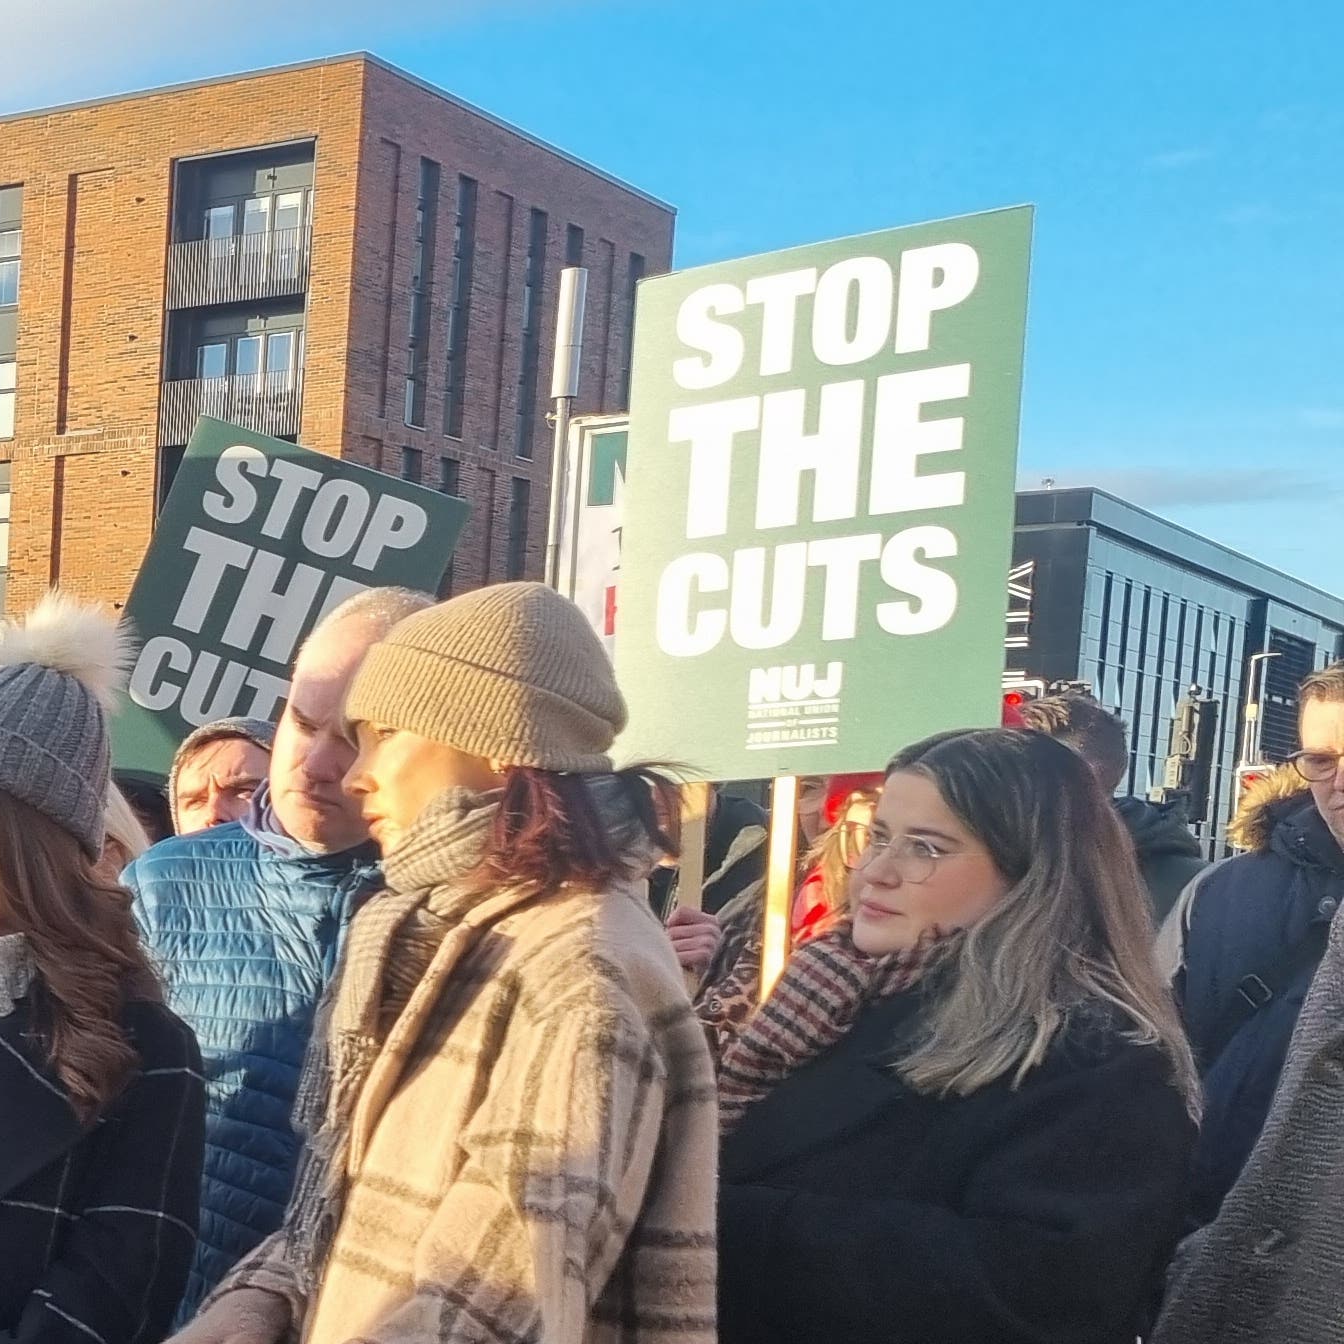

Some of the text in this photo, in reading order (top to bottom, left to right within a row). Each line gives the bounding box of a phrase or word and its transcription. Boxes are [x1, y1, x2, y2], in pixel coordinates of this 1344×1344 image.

[673, 243, 980, 391] STOP
[203, 445, 428, 572] STOP
[668, 363, 971, 540] THE
[656, 525, 959, 658] CUTS
[129, 636, 293, 728] CUT
[748, 662, 843, 704] NUJ
